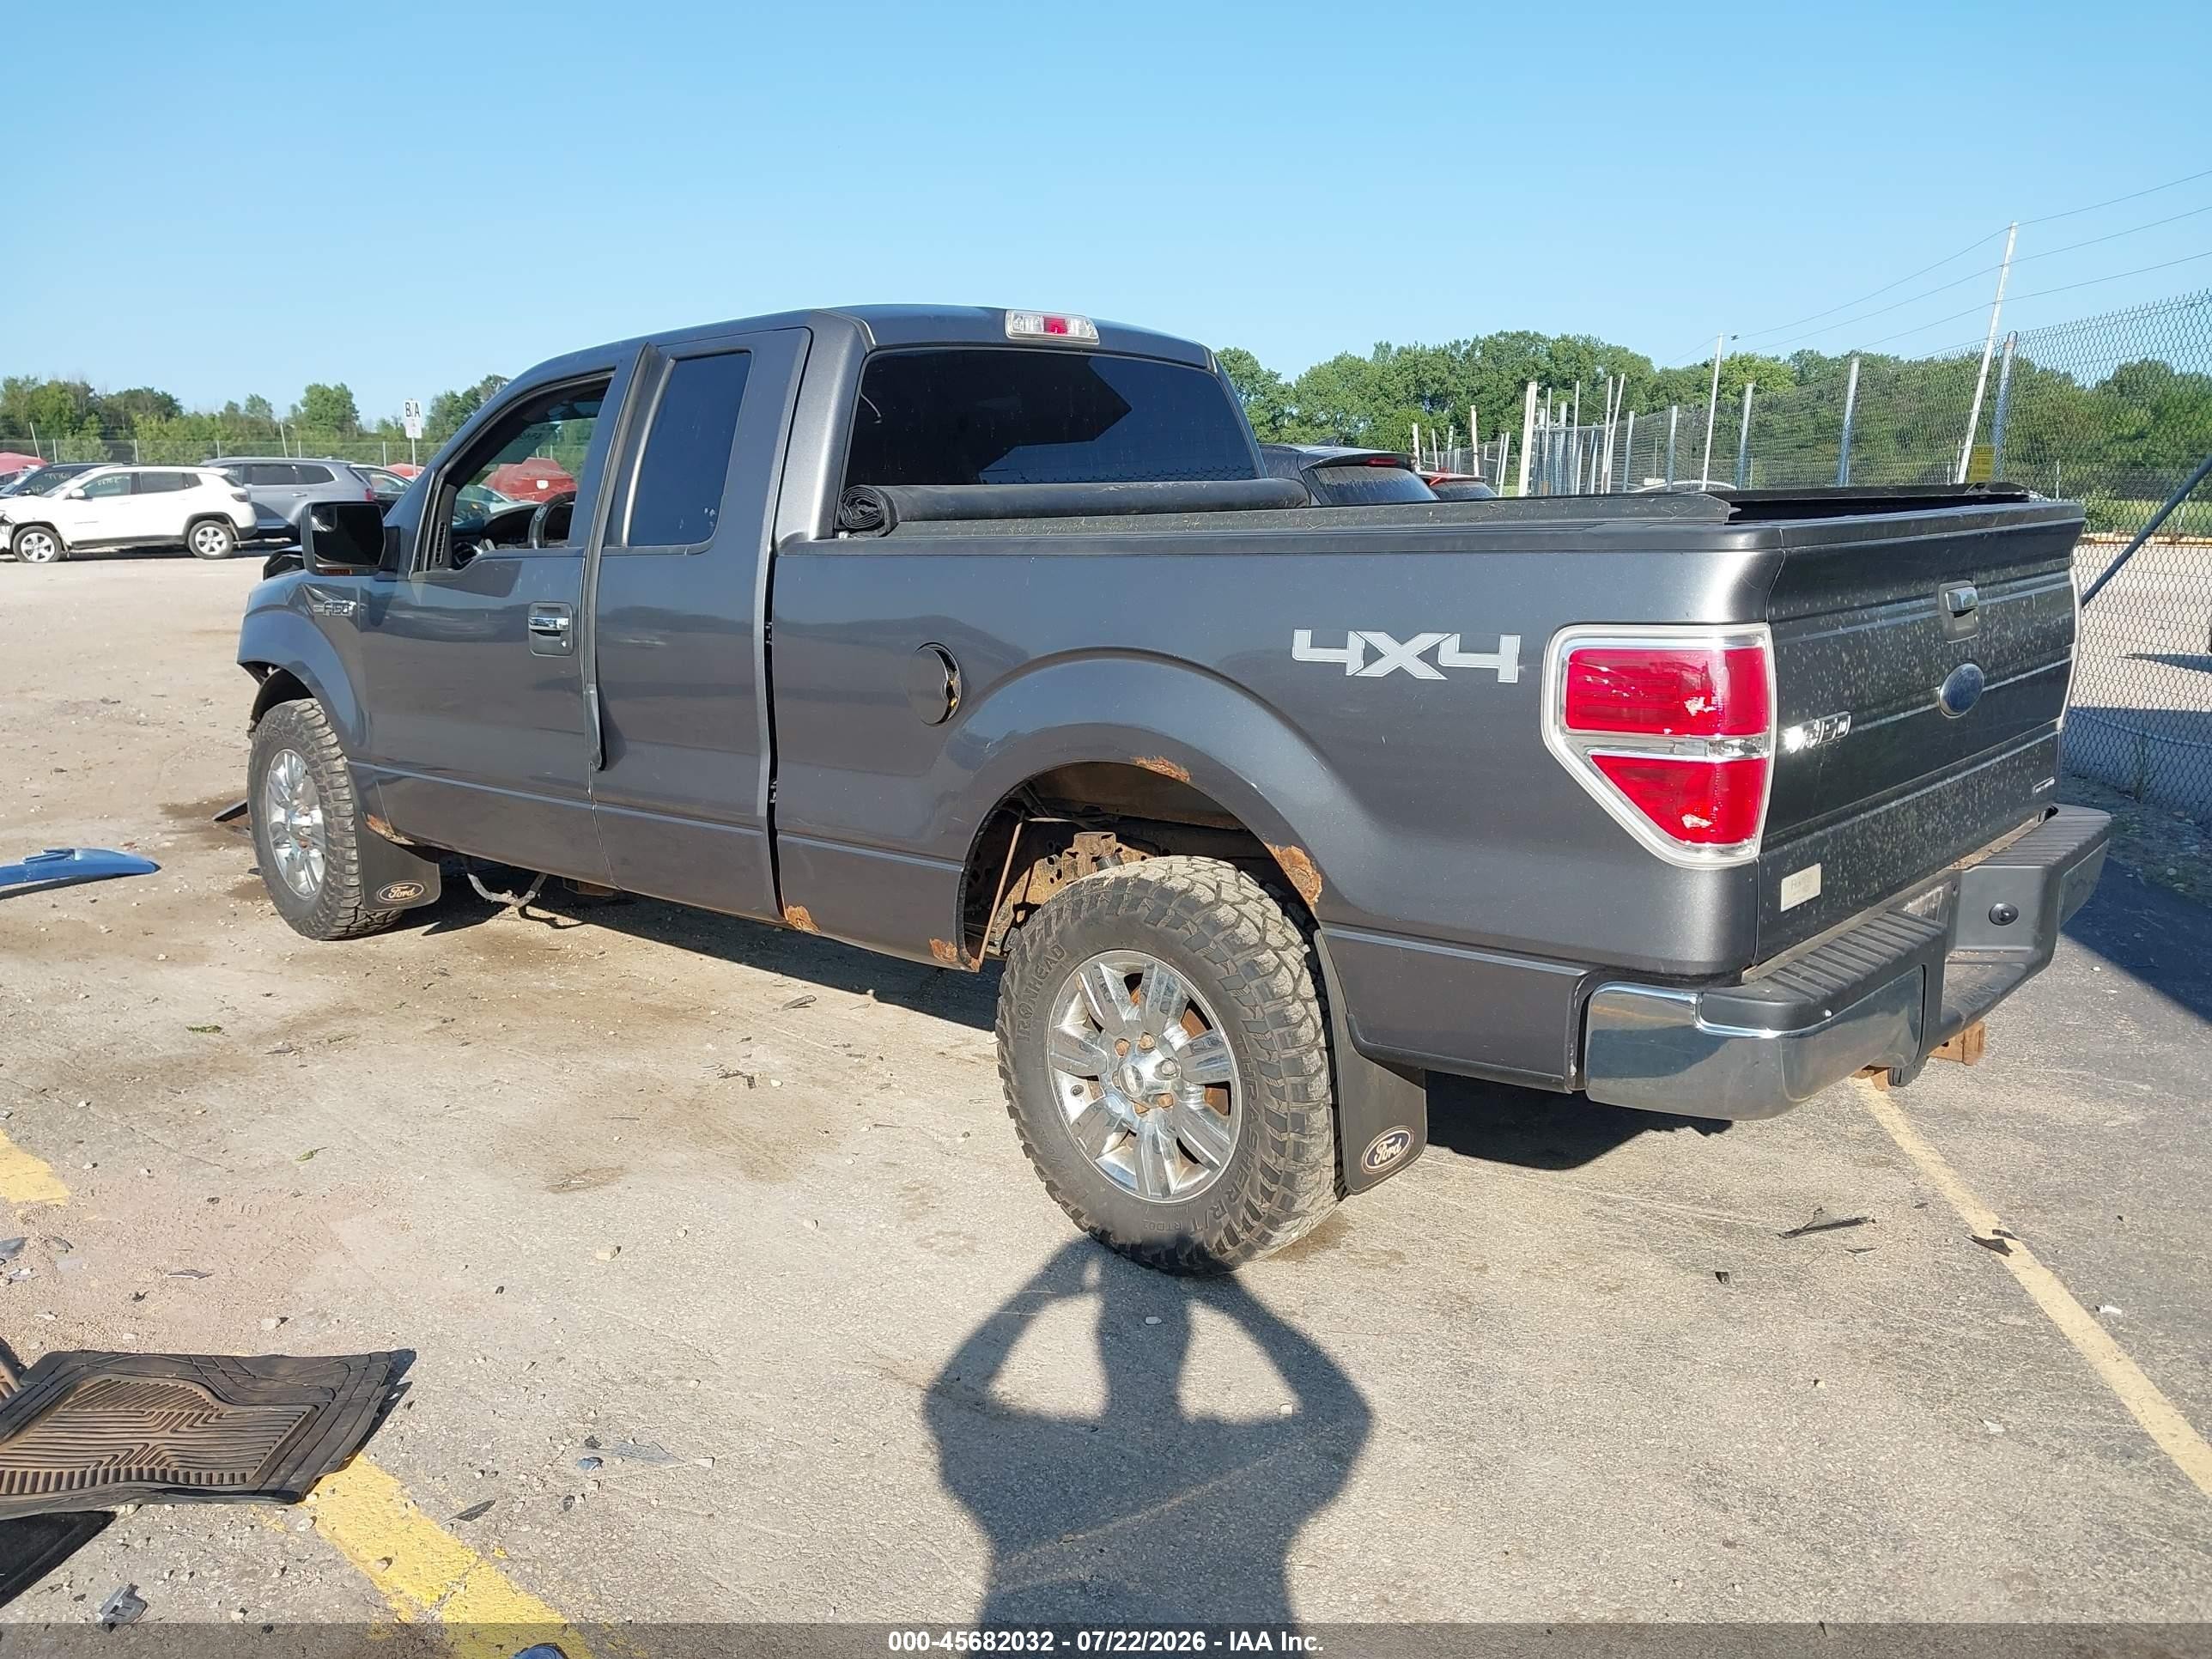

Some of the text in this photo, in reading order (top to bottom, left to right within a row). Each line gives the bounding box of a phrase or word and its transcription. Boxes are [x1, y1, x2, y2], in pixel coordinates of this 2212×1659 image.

[388, 885, 416, 898] Ford
[1016, 944, 1066, 1042] IRONHEAD
[1220, 1033, 1260, 1204] THRASHER
